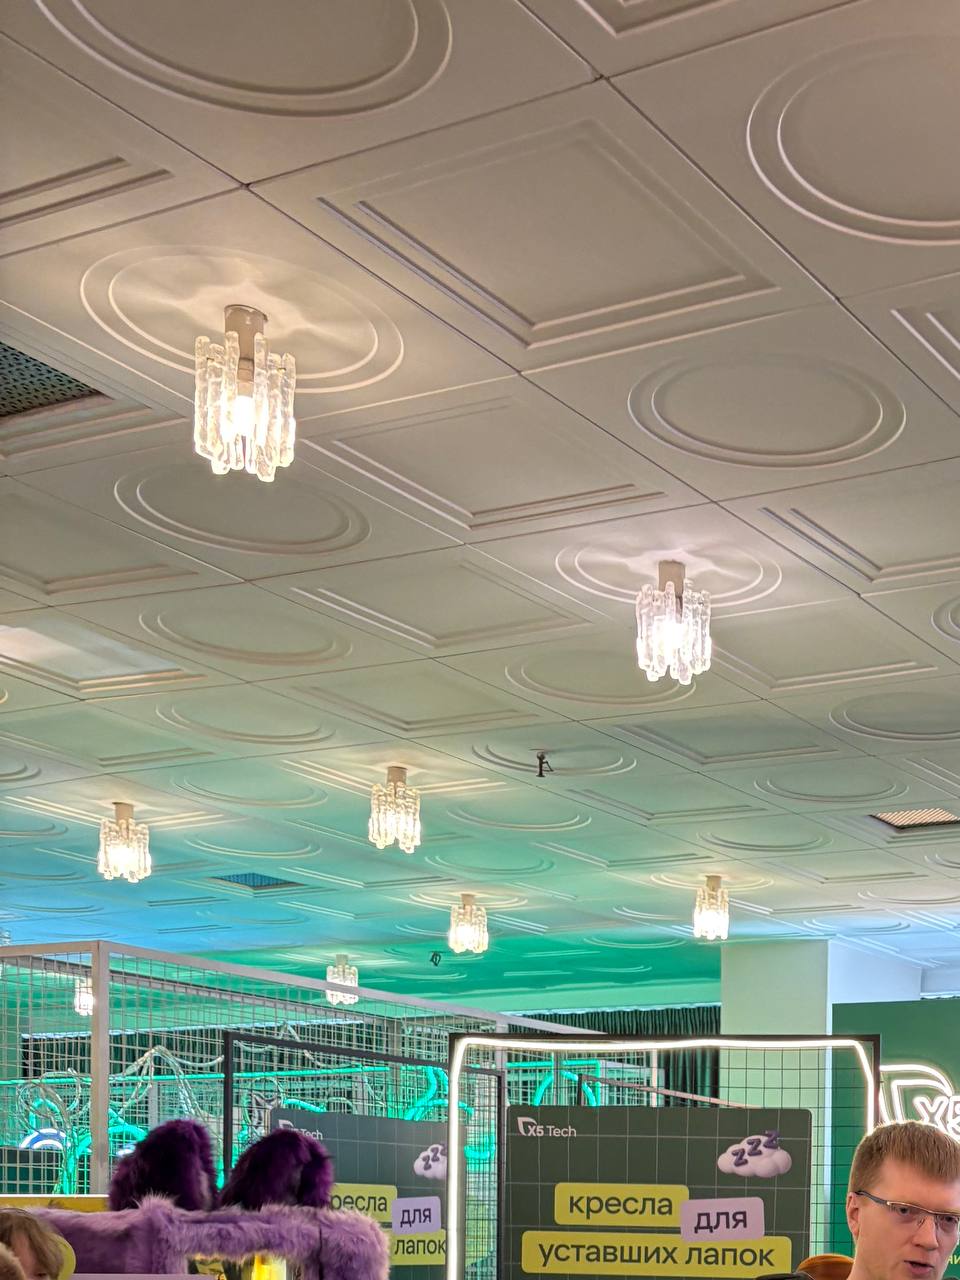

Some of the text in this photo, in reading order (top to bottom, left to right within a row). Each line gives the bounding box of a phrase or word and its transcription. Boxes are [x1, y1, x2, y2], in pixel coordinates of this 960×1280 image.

[528, 1125, 577, 1138] X5 Tech
[399, 1207, 432, 1227] для
[569, 1195, 748, 1234] кресла для
[394, 1238, 446, 1256] лапок
[538, 1242, 775, 1268] уставших лапок
